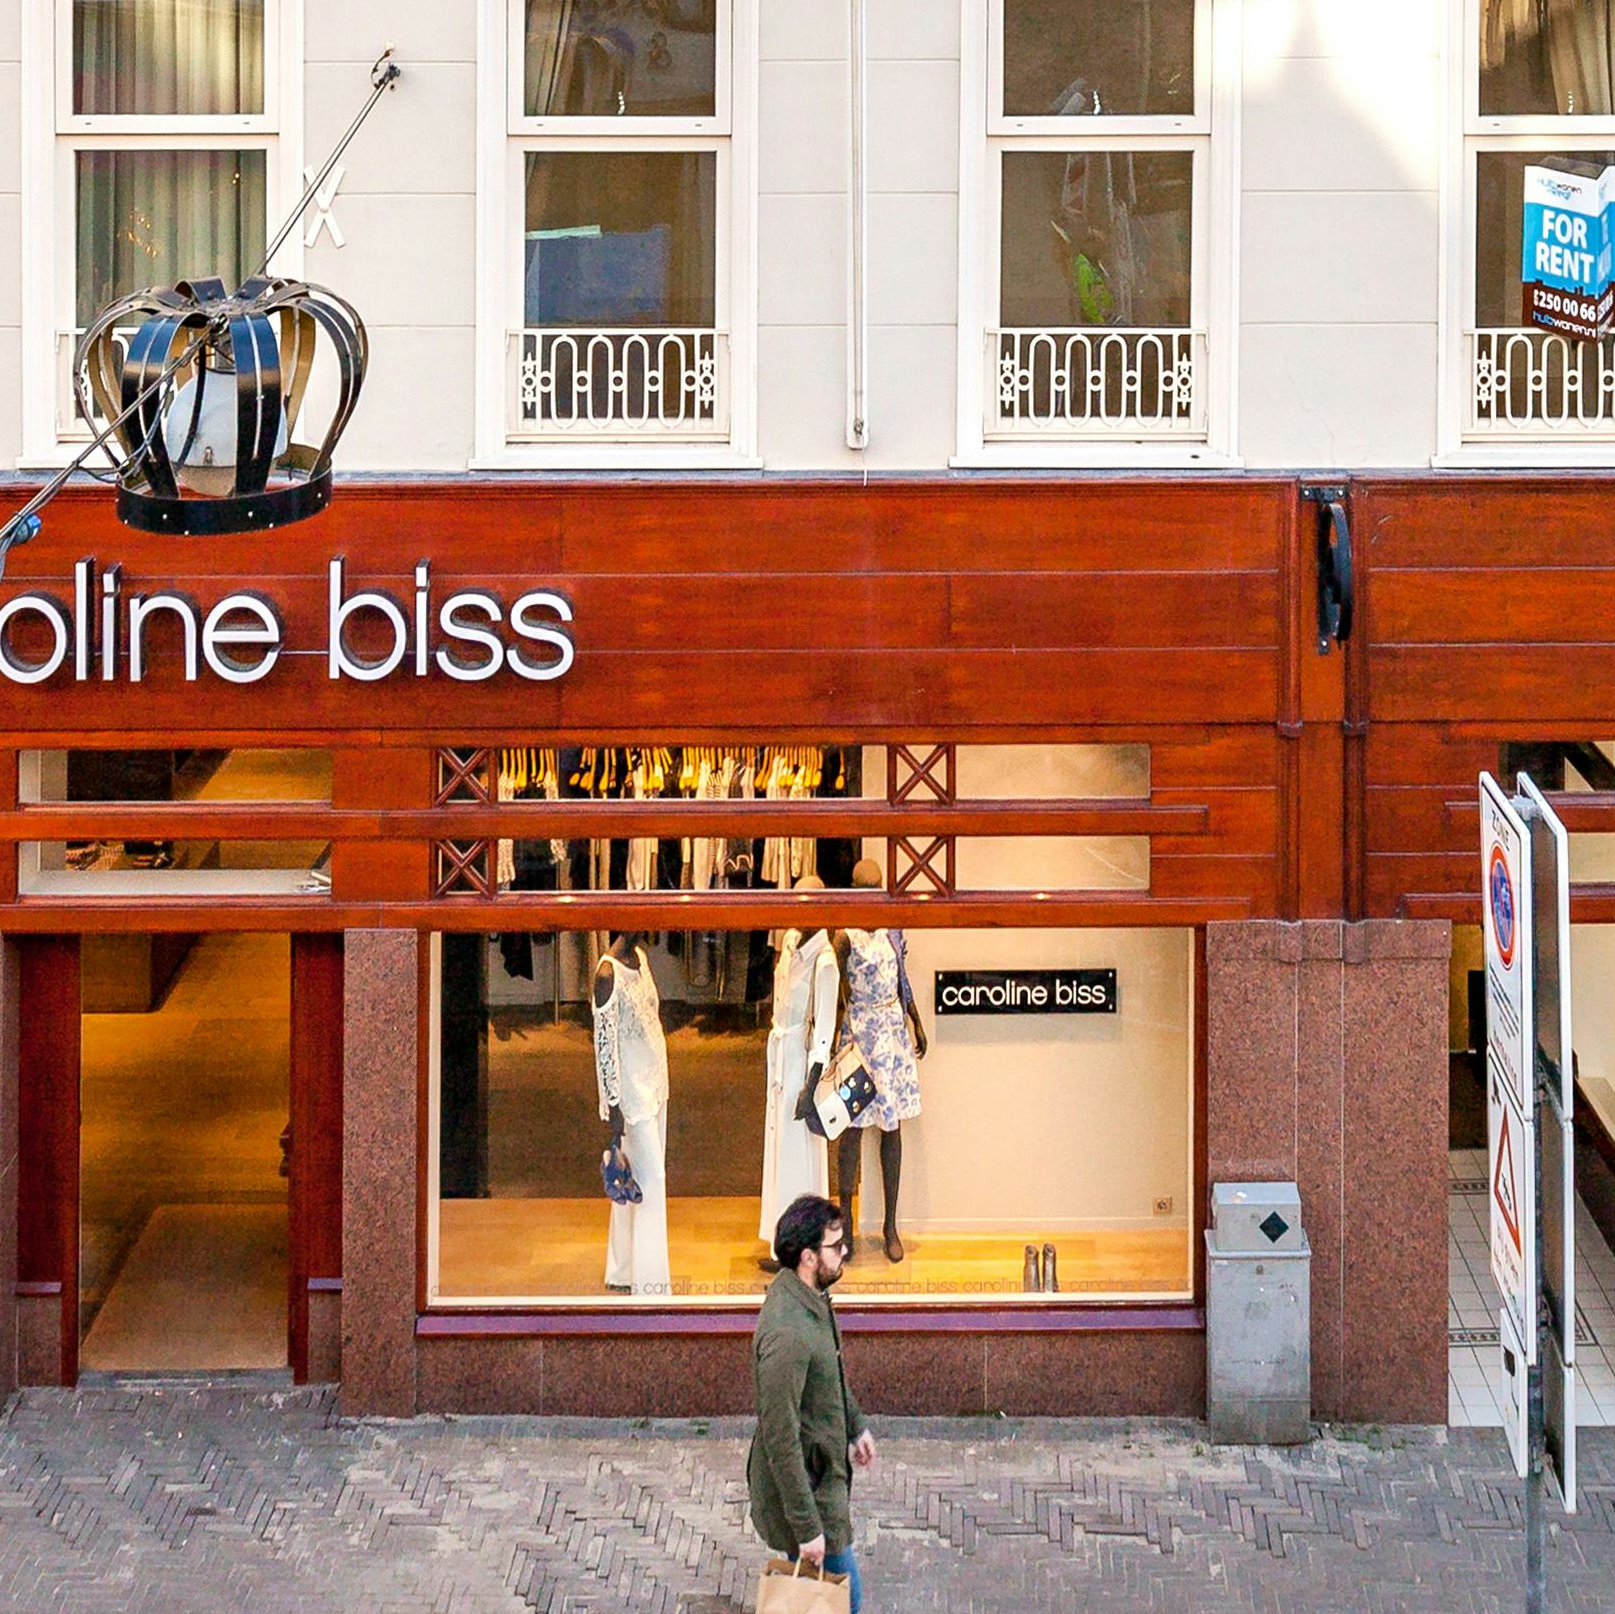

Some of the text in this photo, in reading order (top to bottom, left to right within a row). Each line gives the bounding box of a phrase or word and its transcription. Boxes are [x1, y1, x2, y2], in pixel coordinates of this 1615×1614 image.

[1542, 209, 1587, 249] FOR
[1536, 241, 1595, 284] RENT
[1539, 291, 1561, 312] 250
[1562, 298, 1579, 317] 00
[1579, 304, 1597, 323] 66
[329, 556, 576, 682] biss
[942, 978, 1106, 1006] caroline biss
